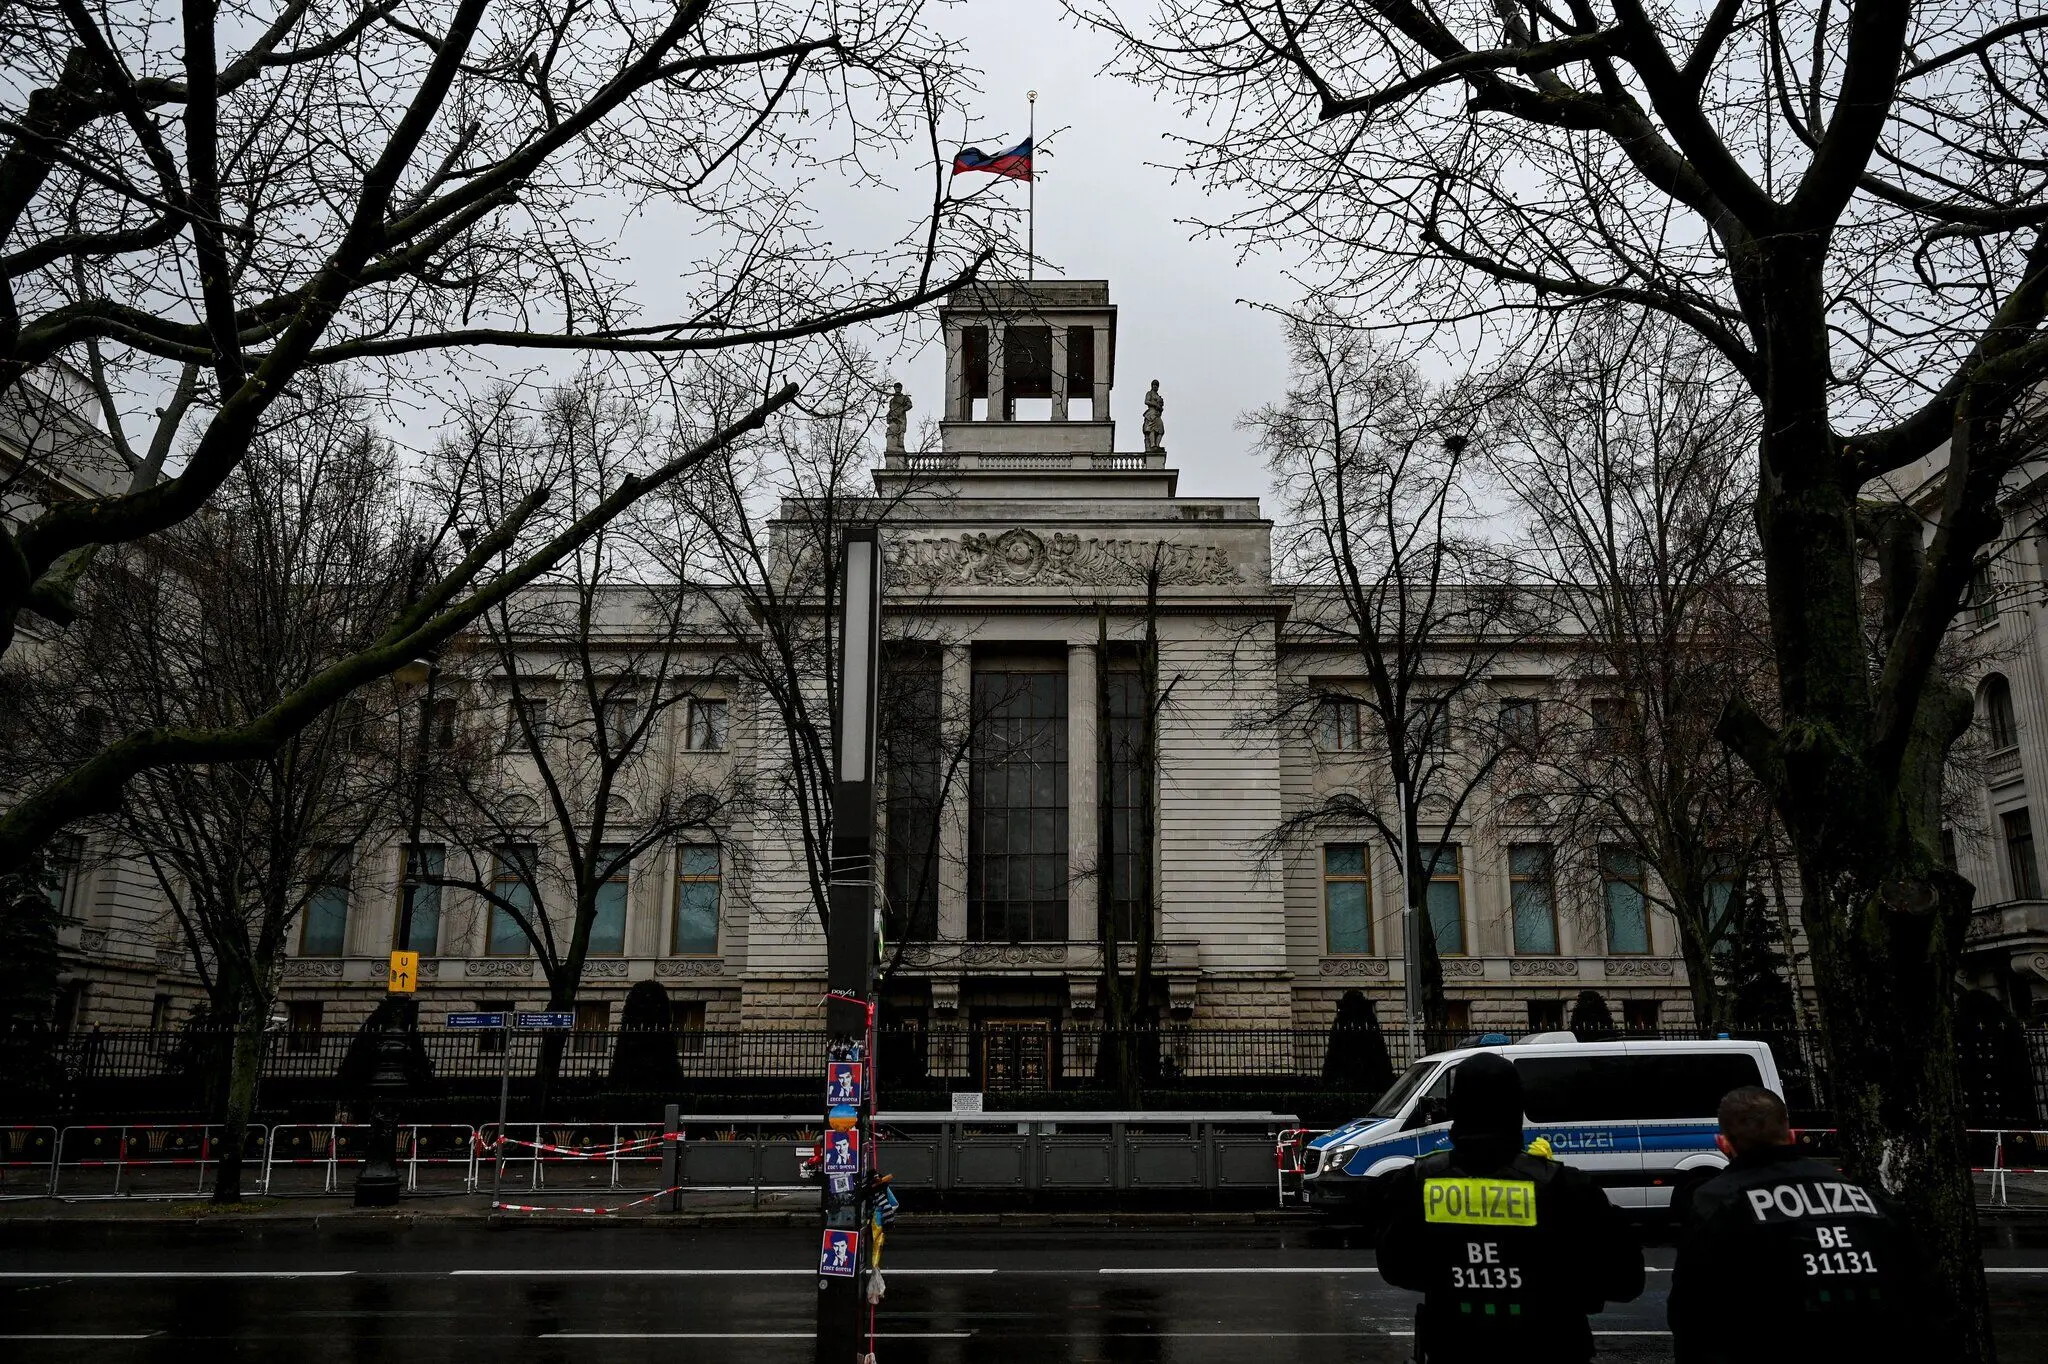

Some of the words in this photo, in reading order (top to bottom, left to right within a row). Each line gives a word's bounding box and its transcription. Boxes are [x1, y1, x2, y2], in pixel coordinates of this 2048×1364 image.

[401, 957, 408, 966] U
[1429, 1185, 1530, 1218] POLIZEI
[1746, 1182, 1878, 1221] POLIZEI
[1816, 1226, 1852, 1248] BE
[1467, 1242, 1500, 1264] BE
[1803, 1251, 1878, 1276] 31131
[1452, 1267, 1522, 1289] 31135
